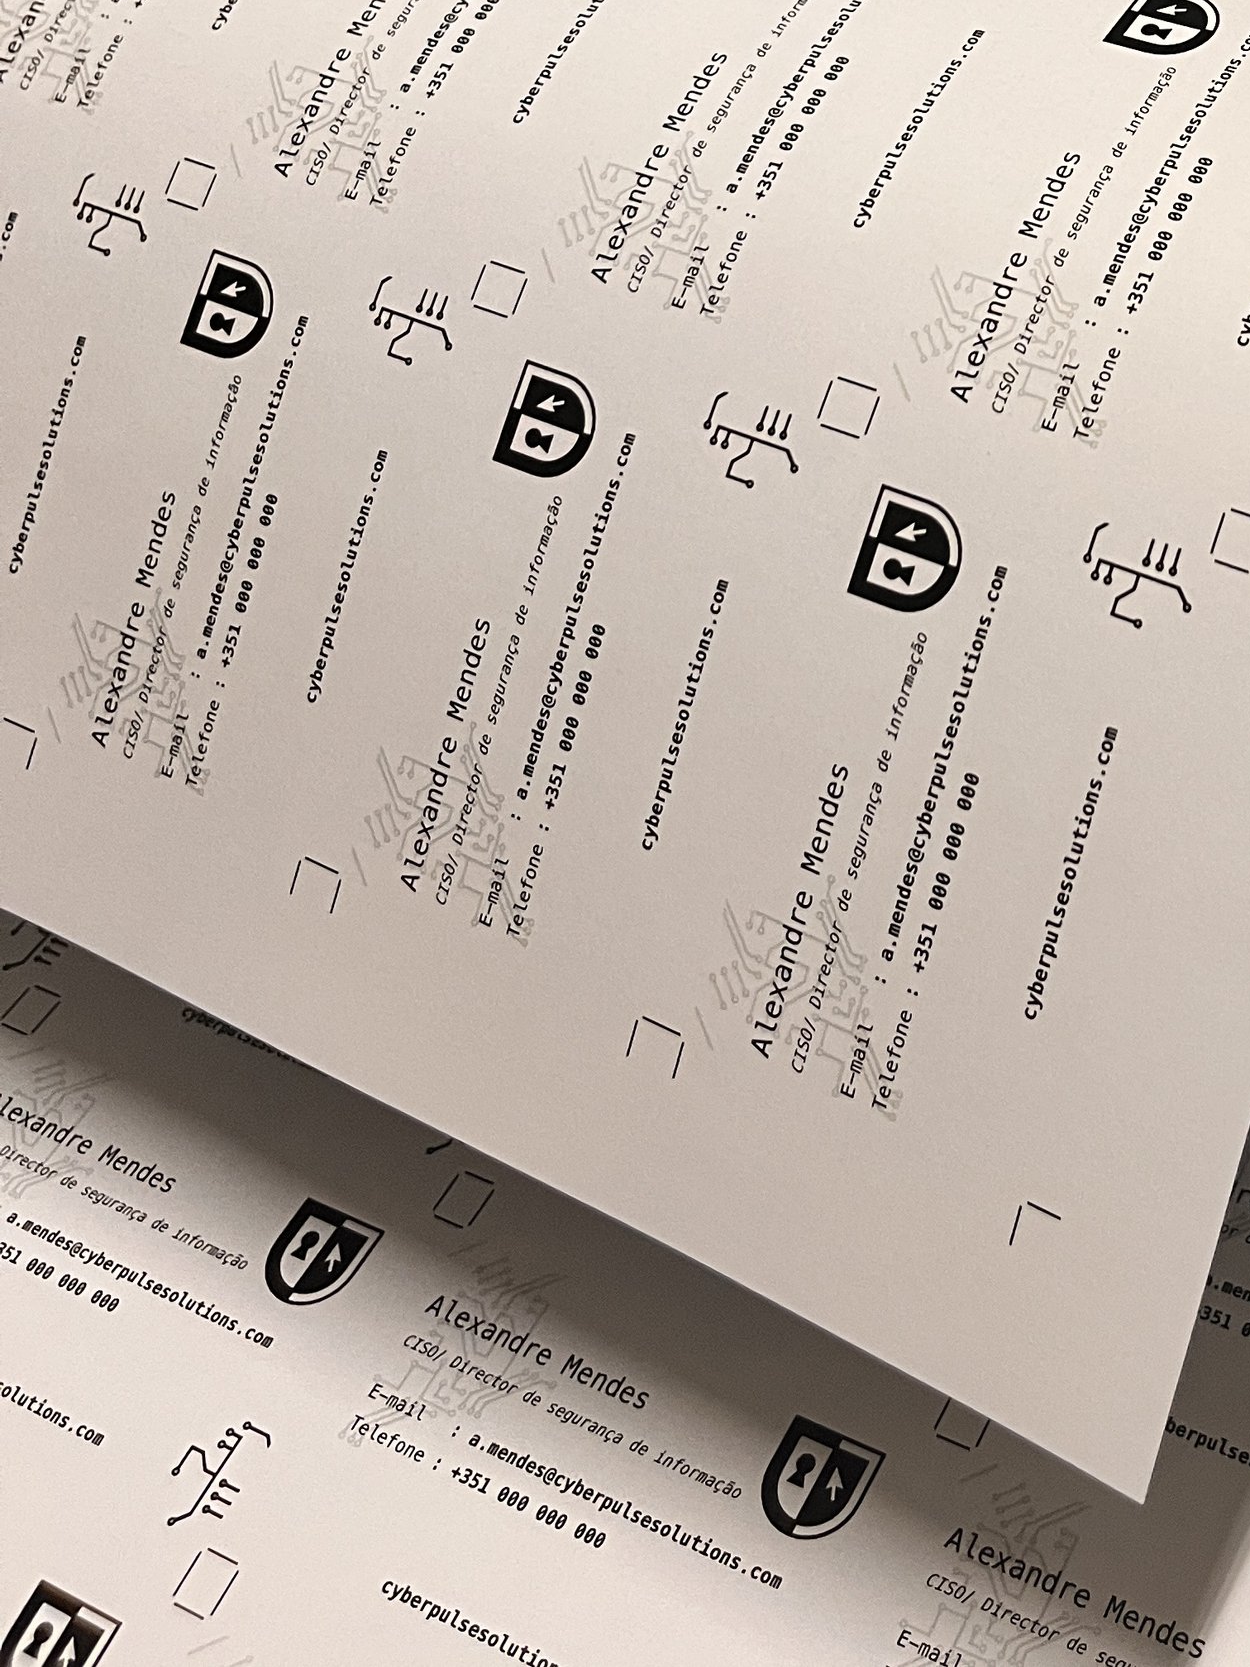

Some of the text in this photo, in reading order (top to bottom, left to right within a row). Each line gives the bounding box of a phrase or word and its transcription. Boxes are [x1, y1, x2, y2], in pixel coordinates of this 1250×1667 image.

[273, 48, 352, 178] Alexandre
[344, 141, 382, 201] E-mail
[590, 52, 728, 284] Alexandre Mendes
[627, 245, 654, 293] CISO/
[650, 164, 692, 239] Director
[692, 140, 708, 158] de
[706, 63, 757, 134] segurança
[756, 42, 772, 58] de
[699, 230, 748, 315] Telefone
[755, 161, 784, 201] +351
[778, 123, 805, 152] 000
[800, 88, 827, 115] 000
[823, 56, 850, 81] 000
[853, 29, 986, 229] cyberpulsesolutions.com
[991, 66, 1177, 414] CISO/ Director de segurança de informação
[670, 246, 710, 310] E-mail
[950, 152, 1081, 404] Alexandre Mendes
[1040, 363, 1080, 432] E-mail
[1072, 347, 1121, 438] Telefone
[1126, 272, 1155, 315] +351
[1147, 230, 1174, 262] 000
[1167, 192, 1193, 222] 000
[1187, 157, 1214, 184] 000
[8, 334, 88, 574] cyberpulsesolutions.com
[123, 374, 242, 760] CISO/ Director de segurança de informação
[160, 713, 190, 779] E-mail
[196, 315, 310, 660] a.mendes@cyberpulsesolutions.com
[306, 449, 388, 704] cyberpulsesolutions.com
[91, 490, 176, 749] Alexandre Mendes
[184, 700, 220, 786] Telefone
[221, 624, 242, 669] +351
[234, 580, 254, 614] 000
[246, 536, 266, 570] 000
[258, 493, 278, 527] 000
[435, 495, 563, 906] CISO/ Director de segurança de informação
[478, 858, 510, 928] E-mail
[516, 432, 637, 801] a.mendes@cyberpulsesolutions.com
[641, 578, 730, 851] cyberpulsesolutions.com
[400, 618, 491, 893] Alexandre Mendes
[506, 844, 544, 936] Telefone
[544, 763, 567, 811] +351
[558, 716, 580, 753] 000
[571, 670, 593, 706] 000
[584, 623, 606, 660] 000
[791, 631, 928, 1074] CISO/ Director de segurança de informação
[839, 1024, 874, 1099] E-mail
[881, 565, 1008, 962] a.mendes@cyberpulsesolutions.com
[1024, 726, 1119, 1021] cyberpulsesolutions.com
[750, 763, 849, 1060] Alexandre Mendes
[871, 1010, 913, 1109] Telefone
[913, 922, 938, 974] +351
[927, 871, 951, 911] 000
[942, 822, 966, 861] 000
[956, 772, 980, 812] 000
[6, 1210, 274, 1348] a.mendes@cyberpulsesolutions.com
[98, 1144, 177, 1193] Mendes
[403, 1334, 742, 1499] CISO/ Director de segurança de informação
[424, 1294, 650, 1410] Alexandre Mendes
[1198, 1304, 1232, 1330] 351
[350, 1414, 425, 1463] Telefone
[451, 1466, 492, 1495] +351
[496, 1486, 530, 1512] 000
[535, 1504, 568, 1530] 000
[573, 1522, 607, 1549] 000
[367, 1383, 427, 1422] E-mail
[468, 1433, 783, 1590] a.mendes@cyberpulsesolutions.com
